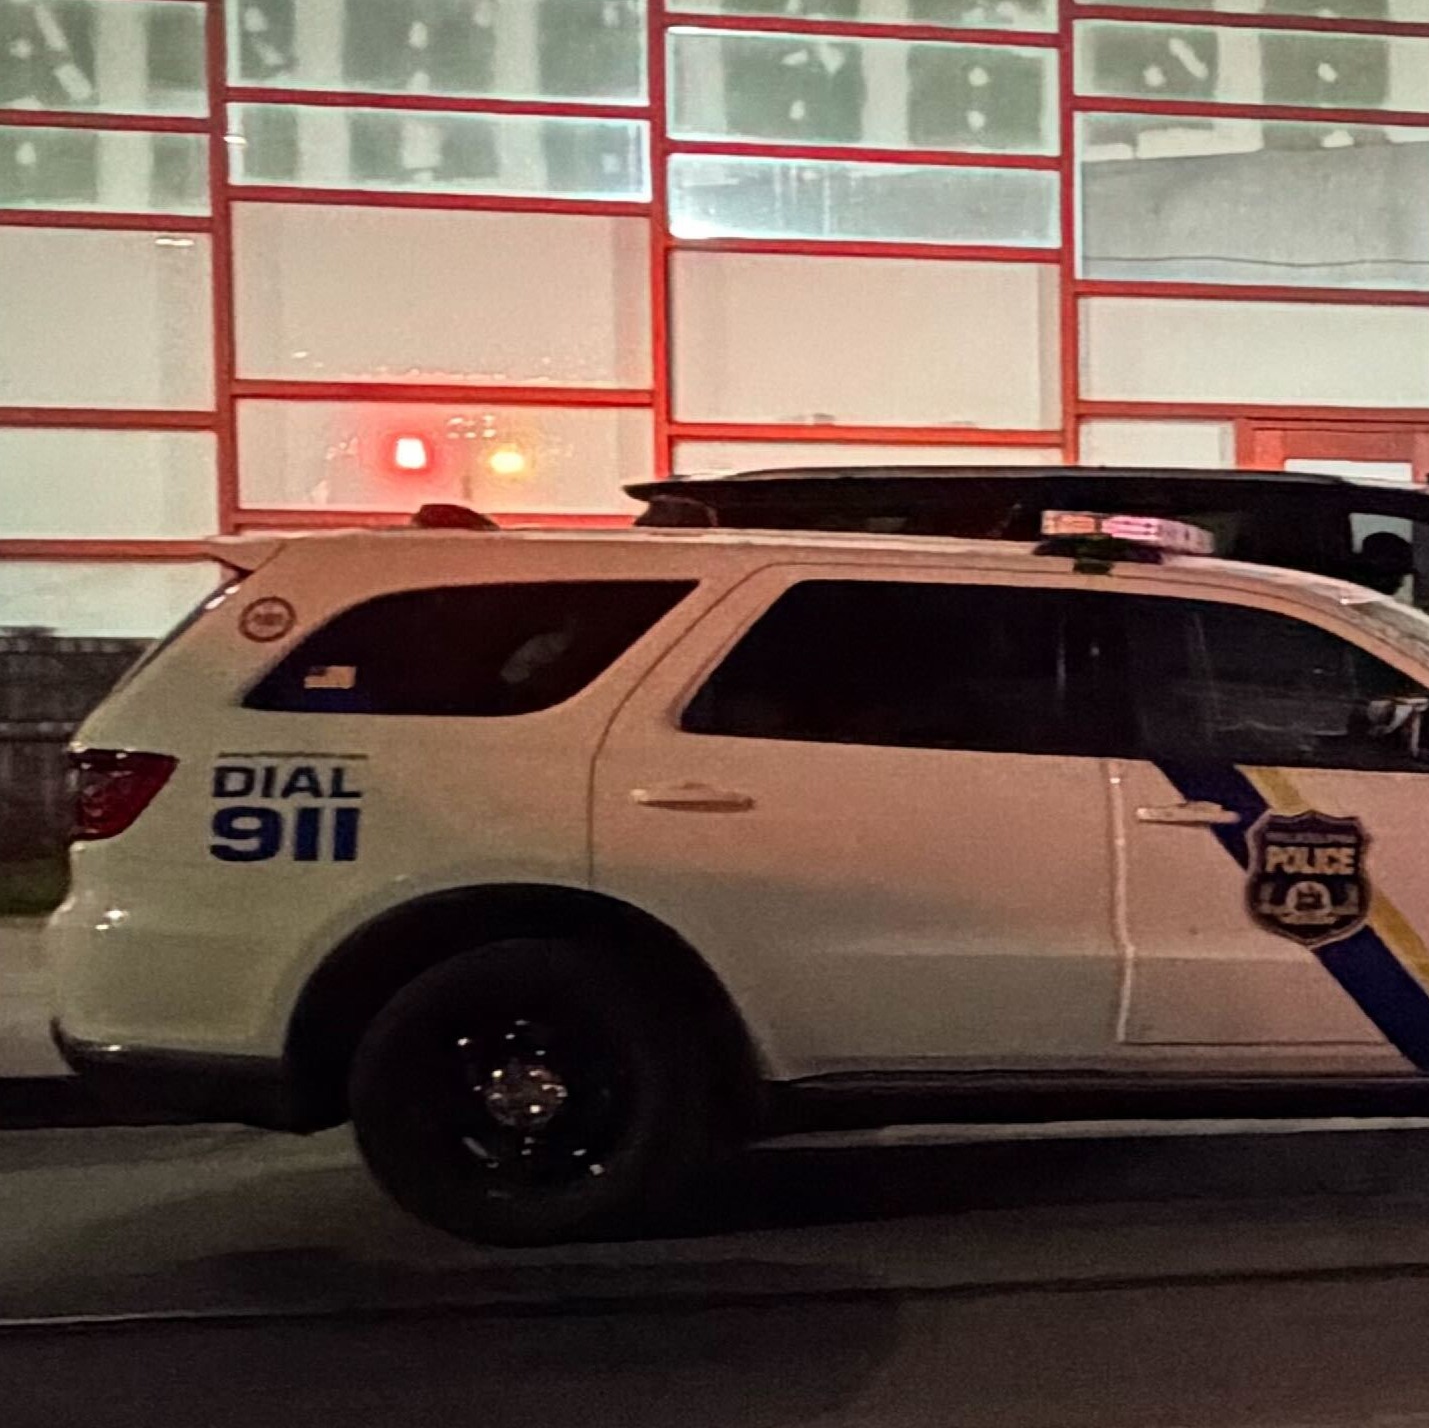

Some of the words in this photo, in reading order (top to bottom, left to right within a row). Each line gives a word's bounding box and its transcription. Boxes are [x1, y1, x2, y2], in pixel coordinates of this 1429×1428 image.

[212, 766, 363, 799] DIAL
[210, 805, 361, 863] 911
[1265, 844, 1356, 875] POLICE
